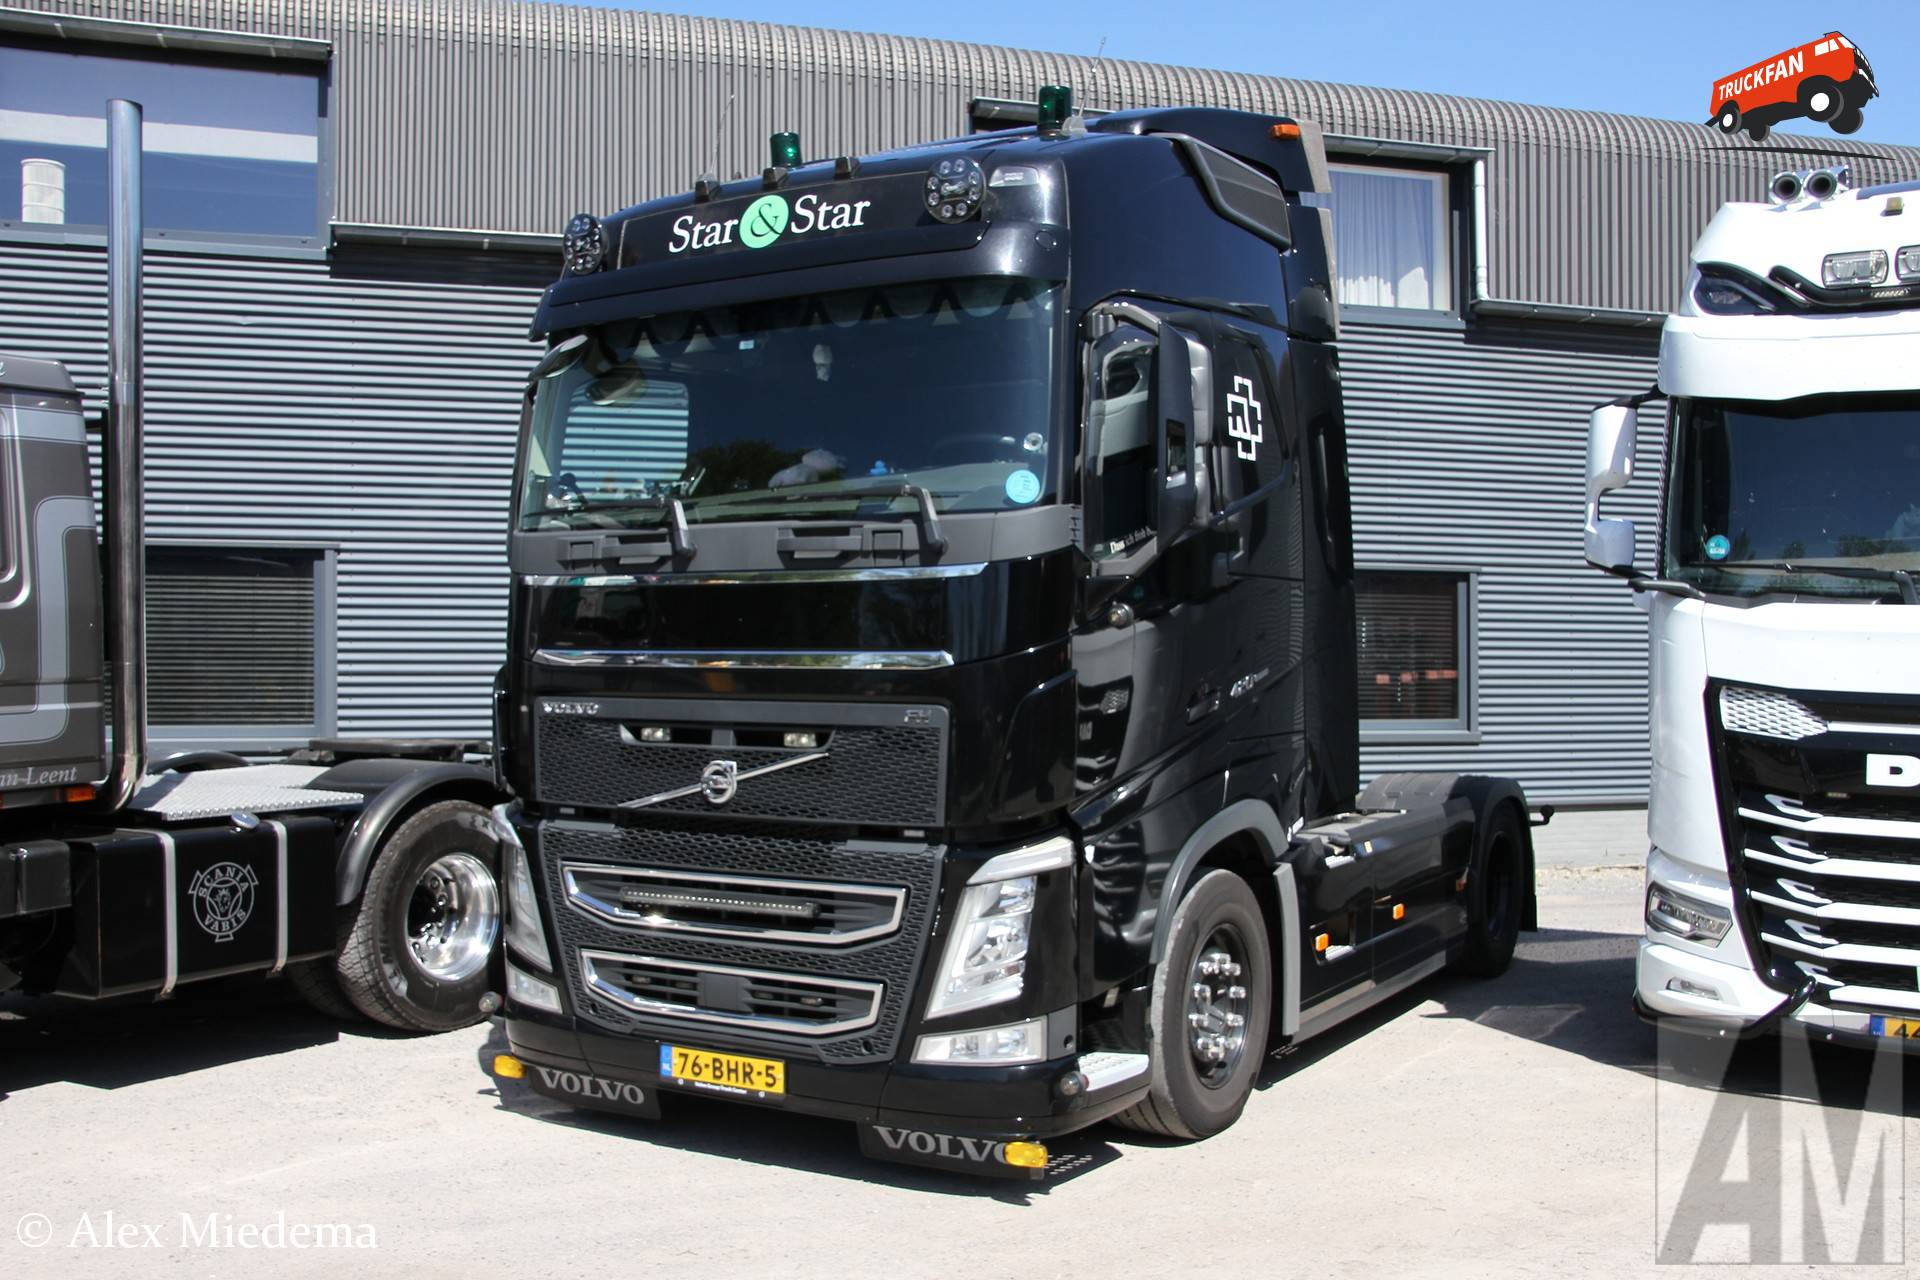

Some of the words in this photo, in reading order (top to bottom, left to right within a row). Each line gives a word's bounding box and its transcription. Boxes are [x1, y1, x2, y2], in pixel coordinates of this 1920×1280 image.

[668, 214, 739, 253] Star
[750, 202, 783, 237] &
[791, 194, 871, 234] Star
[541, 701, 599, 715] VOLVO
[198, 866, 249, 898] SCANIA
[204, 909, 246, 932] VABIS
[535, 1066, 645, 1105] VOLVO
[679, 1053, 777, 1089] 76-BHR-5
